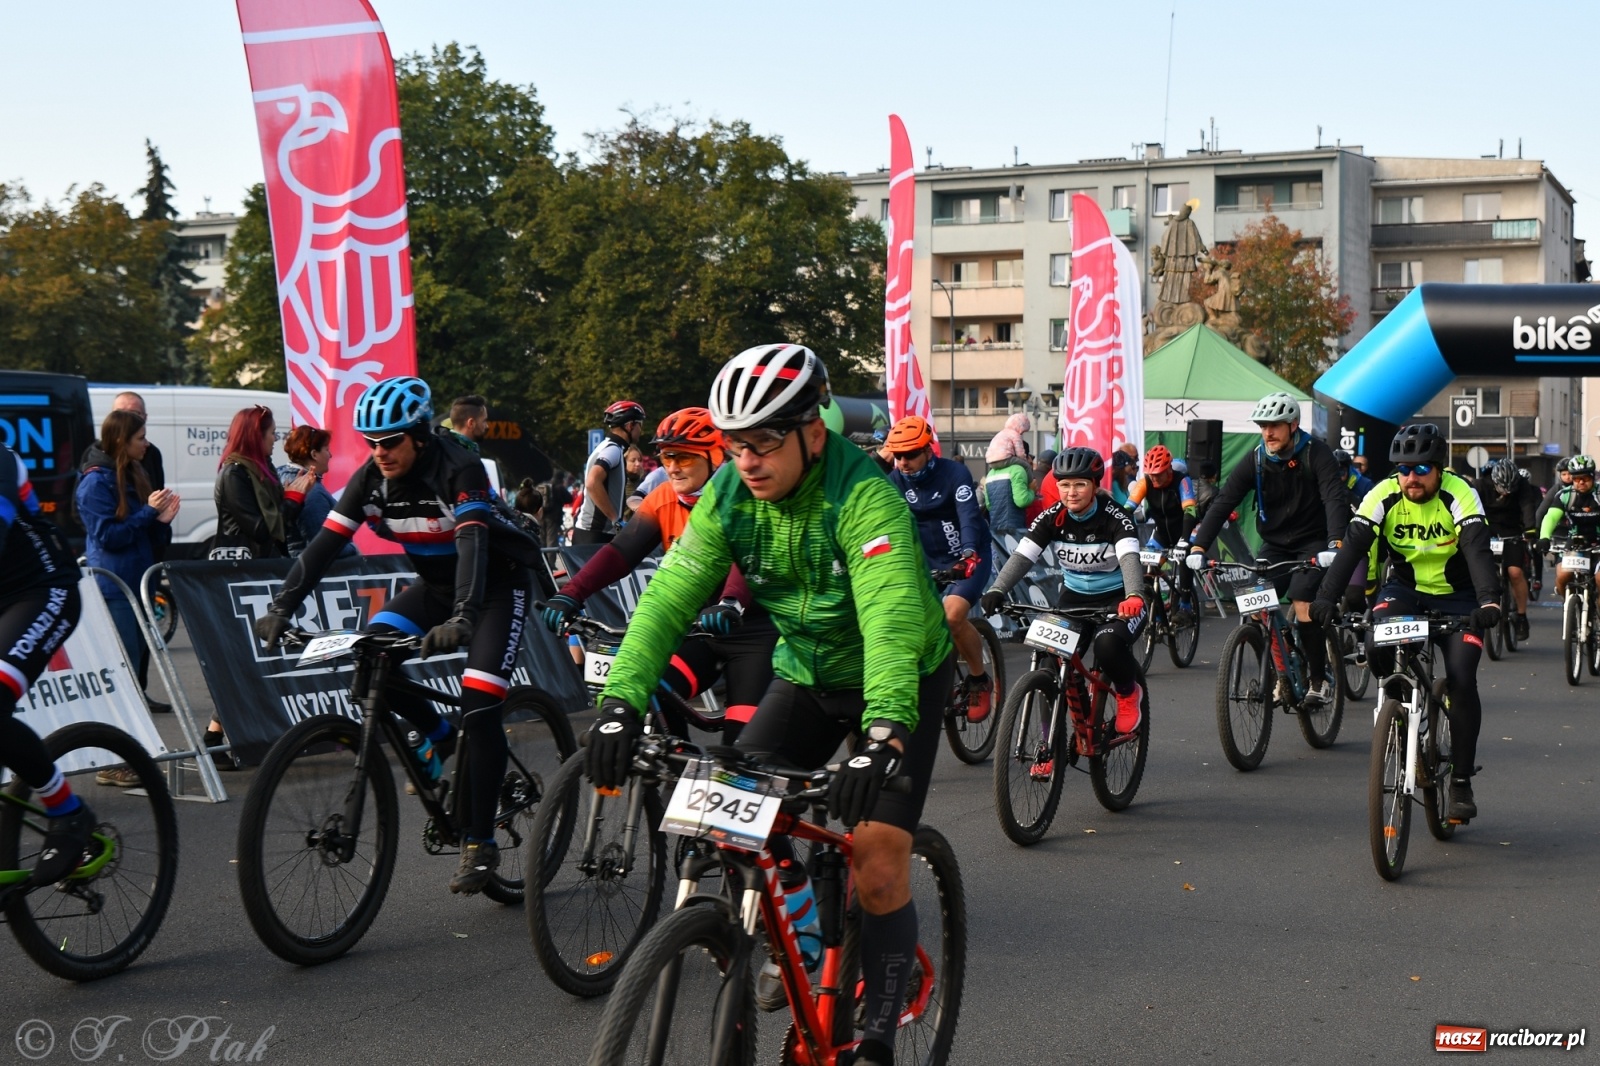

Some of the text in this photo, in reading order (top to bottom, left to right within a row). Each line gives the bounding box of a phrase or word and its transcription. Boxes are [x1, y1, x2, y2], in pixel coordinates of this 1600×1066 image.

[1513, 316, 1592, 350] bike
[1456, 405, 1473, 426] 0
[1243, 593, 1271, 607] 3090
[8, 611, 56, 660] TOMAZI
[501, 618, 524, 671] TOMAZI
[513, 589, 526, 617] BIKE
[1036, 626, 1069, 645] 3228
[1384, 624, 1420, 635] 3184
[687, 788, 761, 823] 2945
